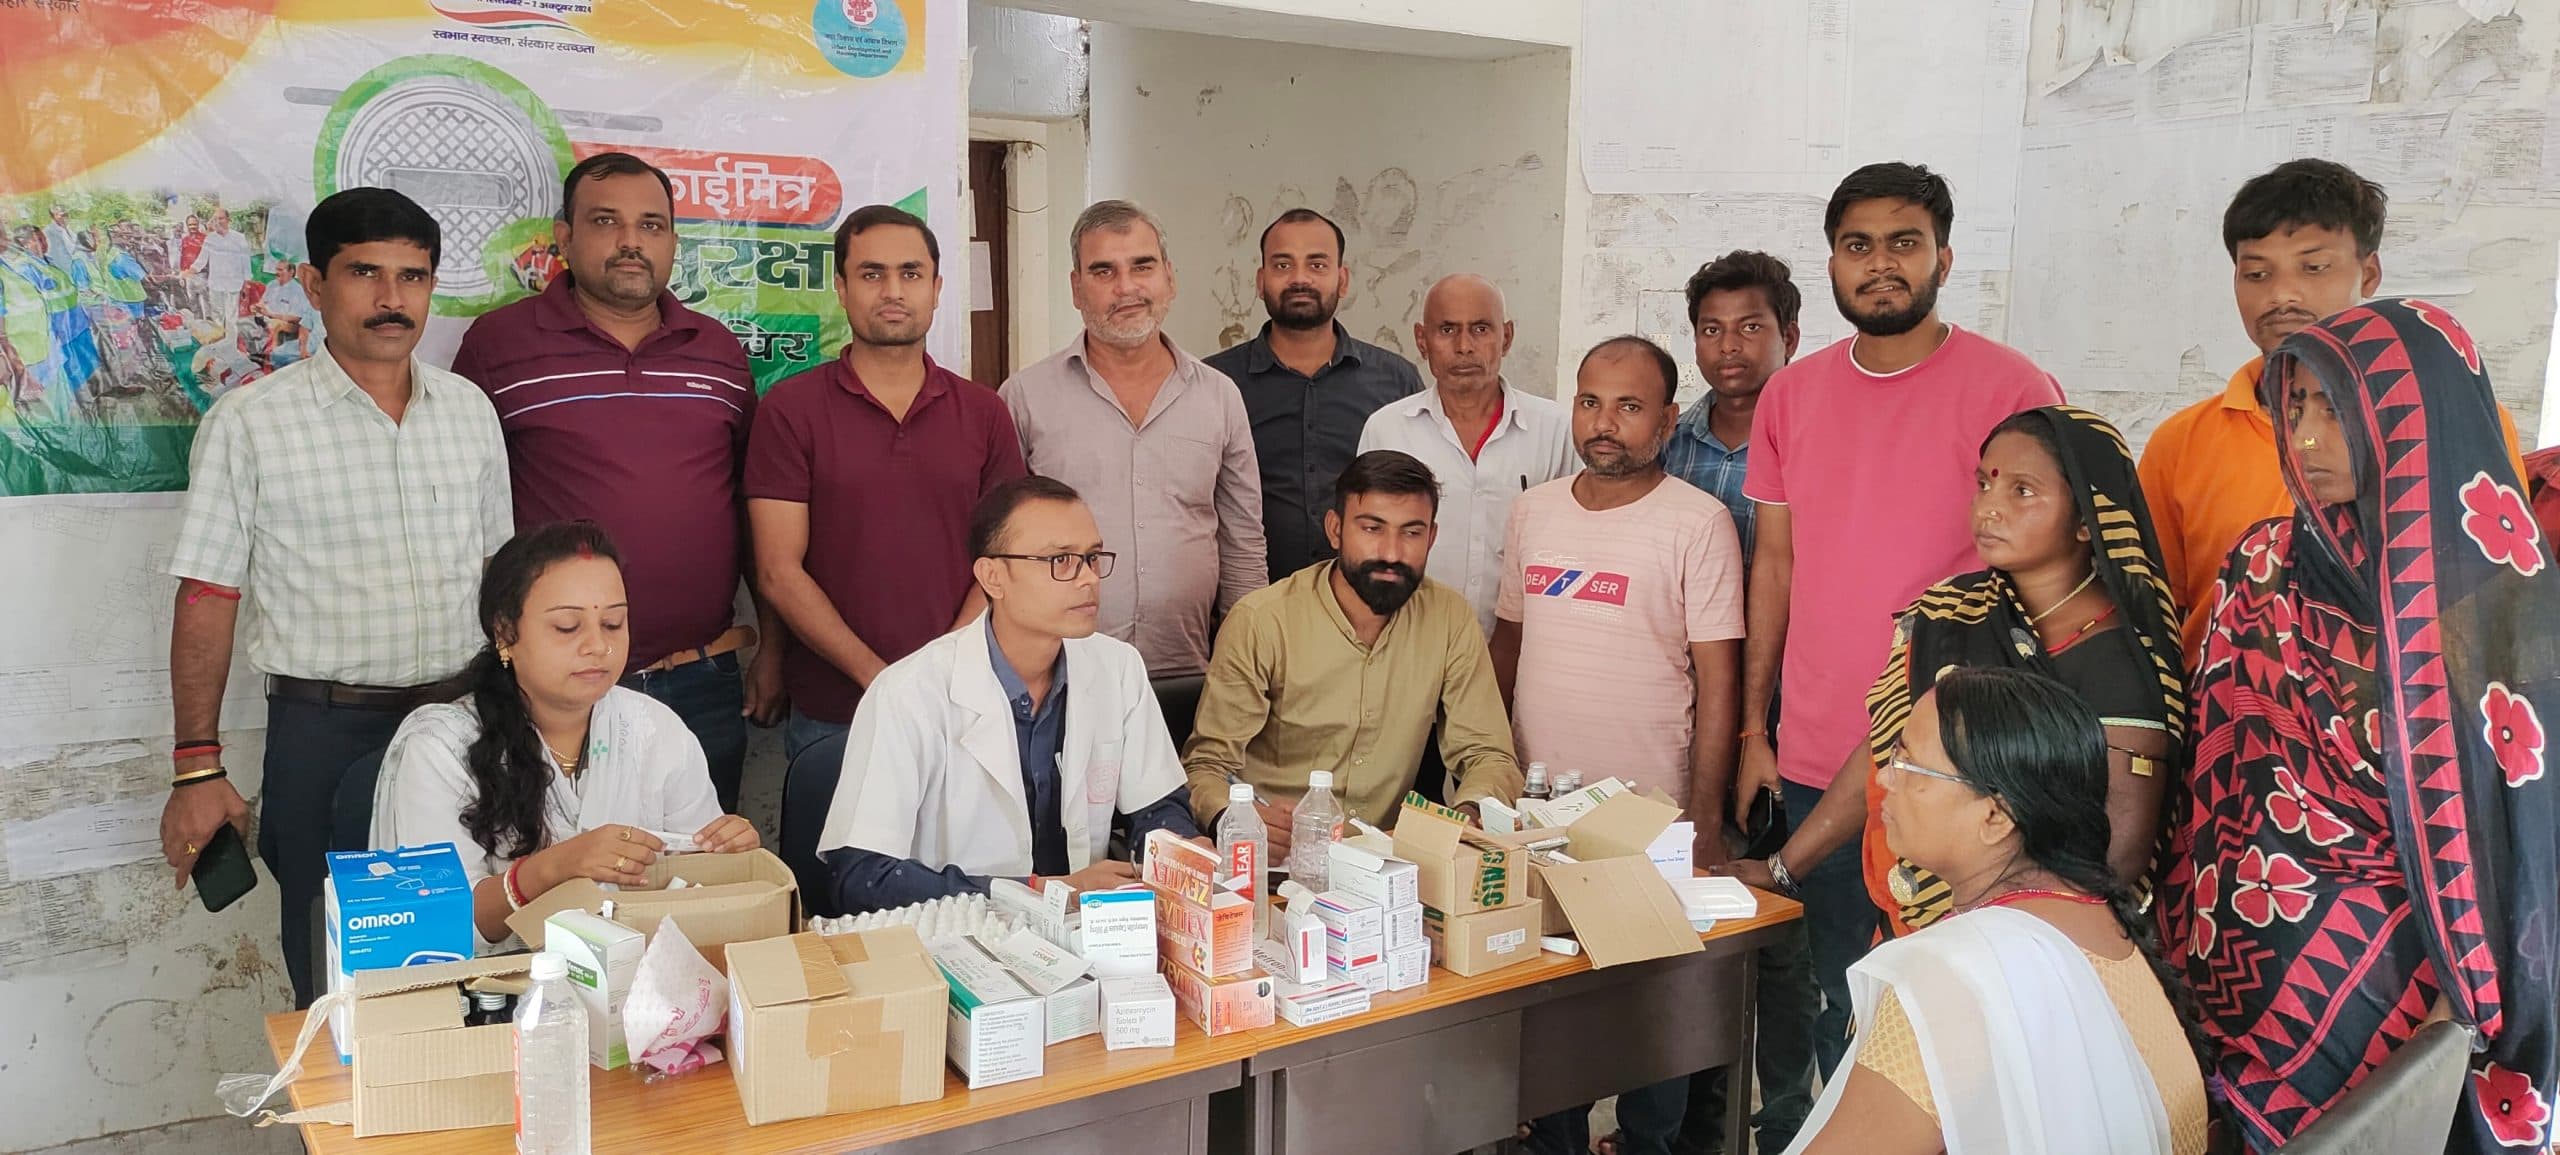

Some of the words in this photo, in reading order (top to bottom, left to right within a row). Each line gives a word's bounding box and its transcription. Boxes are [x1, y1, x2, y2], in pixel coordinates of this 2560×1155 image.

[1526, 573, 1547, 587] DEA
[1590, 580, 1619, 596] SER
[348, 911, 415, 931] OMRON
[1158, 897, 1208, 944] EVITEX
